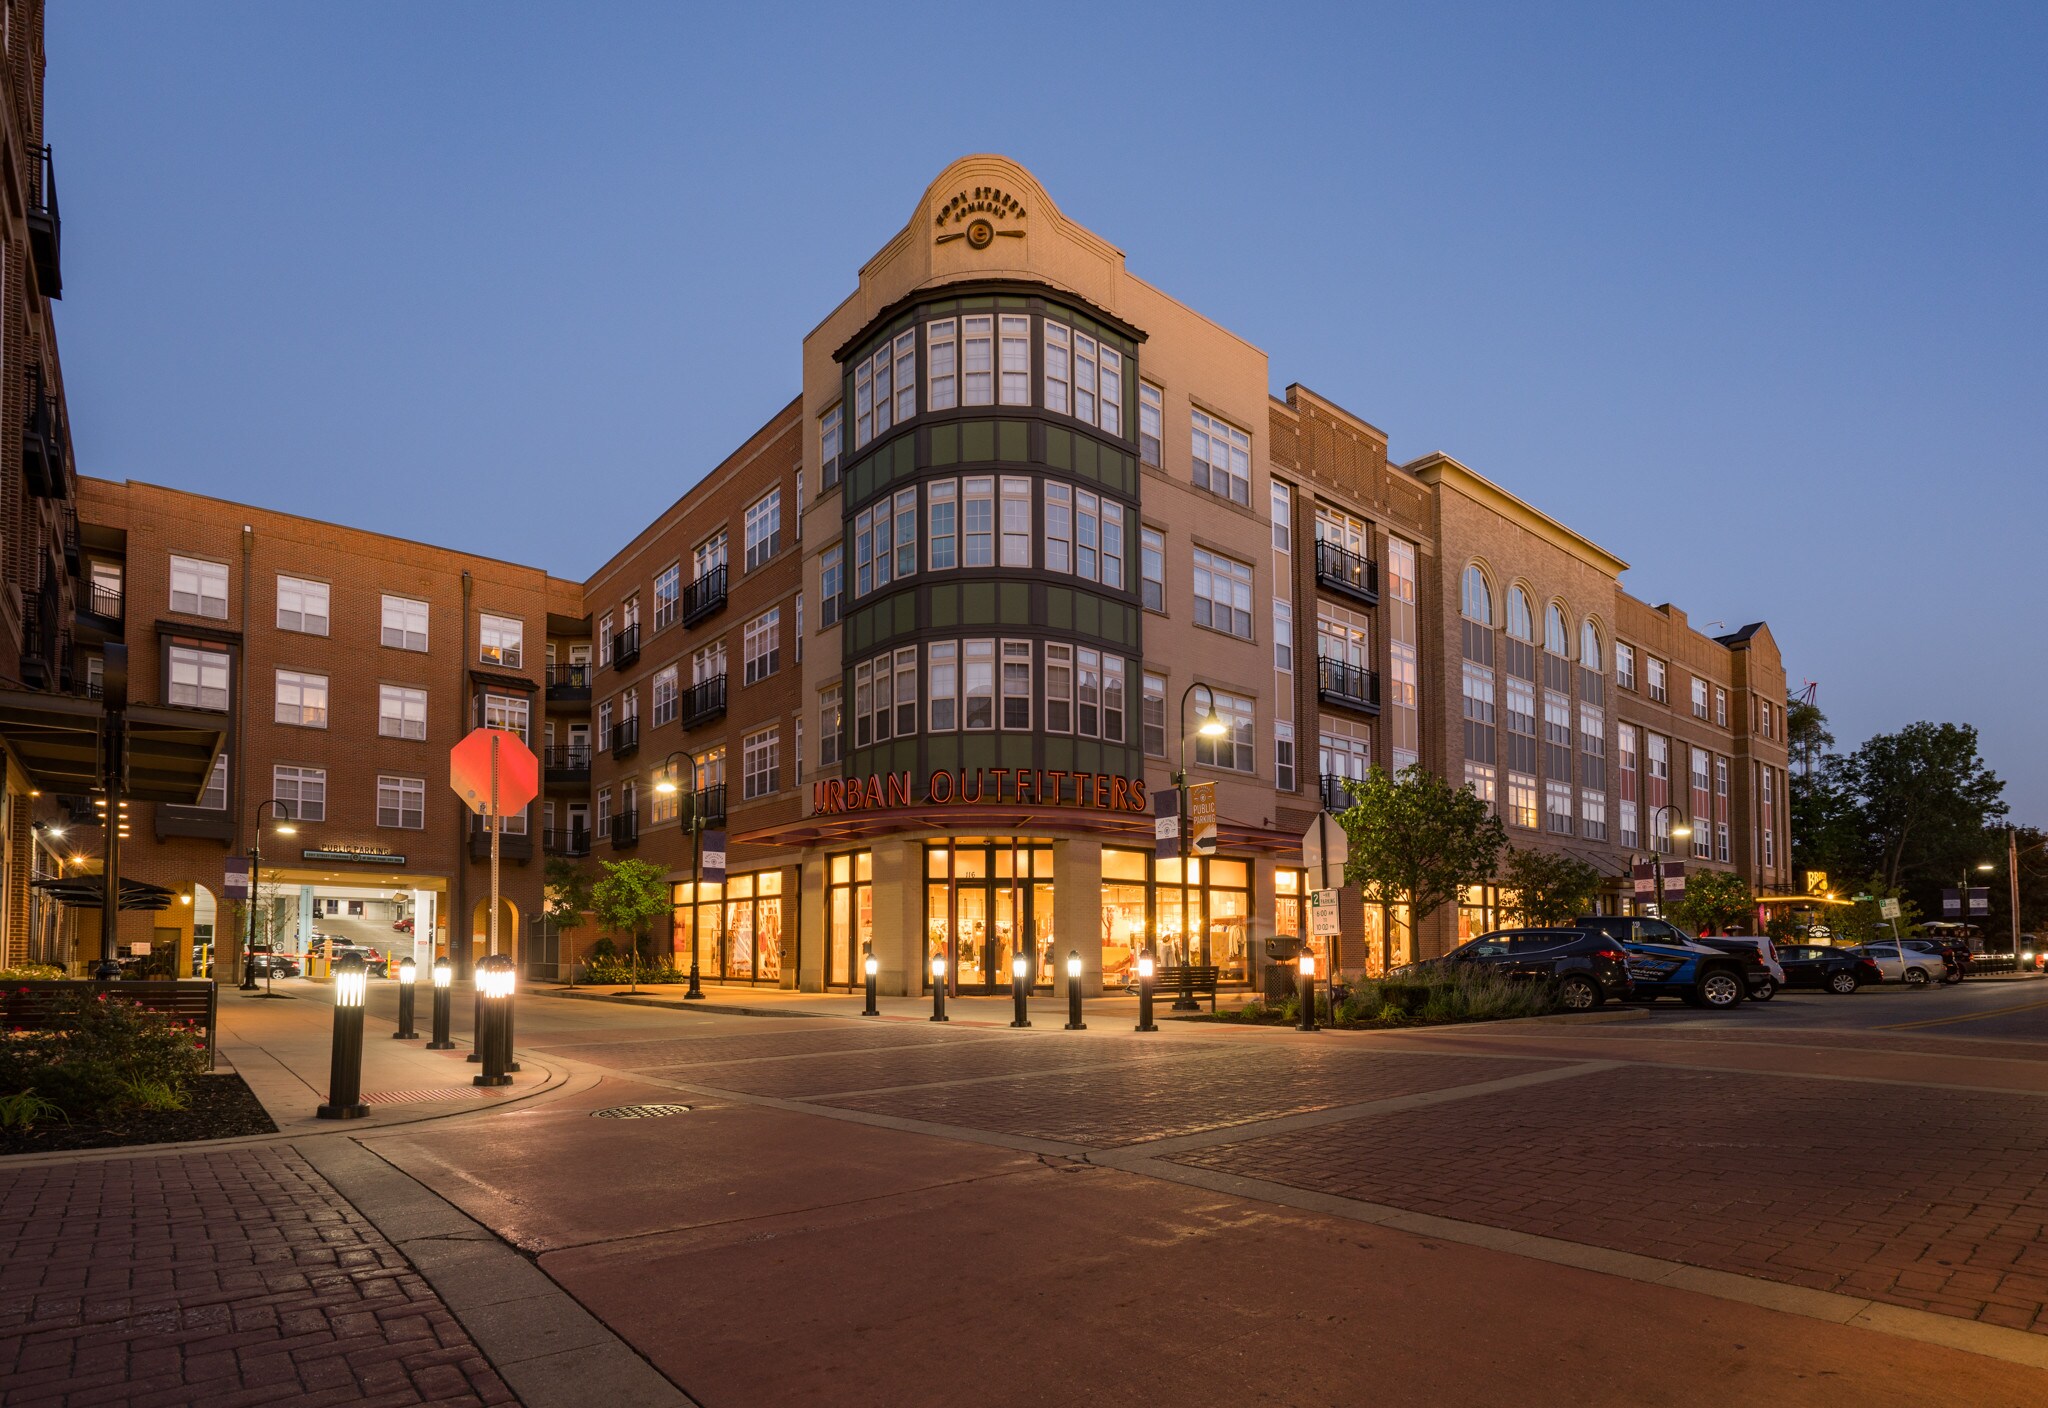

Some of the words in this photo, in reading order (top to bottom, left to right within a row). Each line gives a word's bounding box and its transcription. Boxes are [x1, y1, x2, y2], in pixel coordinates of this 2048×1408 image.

[975, 187, 1026, 219] STREET
[955, 201, 1006, 222] COMMONS
[813, 770, 912, 815] URBAN
[929, 767, 1147, 812] OUTFITTERS
[1193, 802, 1215, 815] PUBLIC
[1193, 814, 1216, 825] PARKING
[321, 844, 351, 853] PUBLIC
[354, 846, 389, 854] PARKING
[965, 871, 976, 879] 116
[1313, 894, 1318, 904] 2
